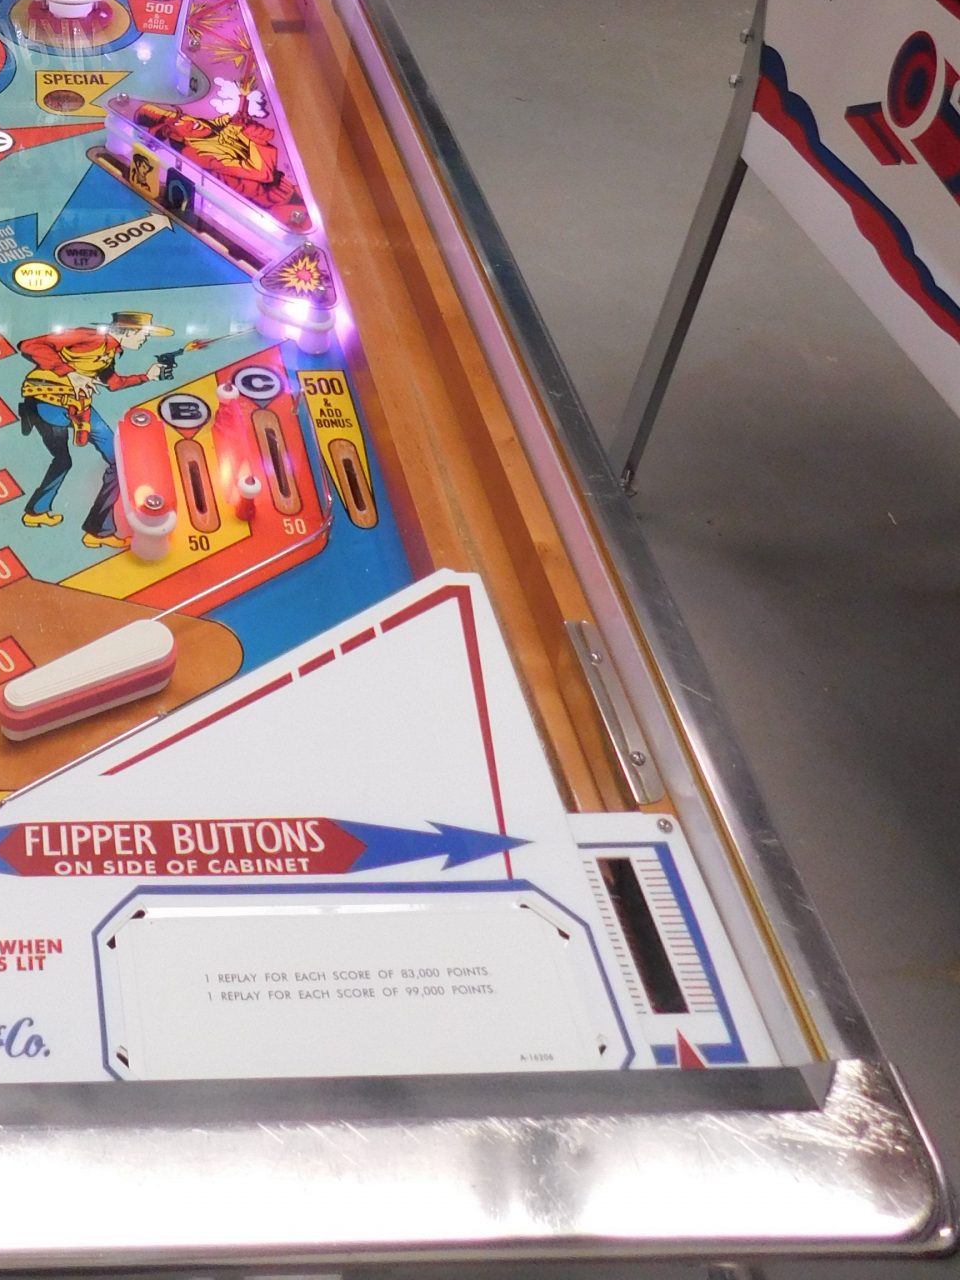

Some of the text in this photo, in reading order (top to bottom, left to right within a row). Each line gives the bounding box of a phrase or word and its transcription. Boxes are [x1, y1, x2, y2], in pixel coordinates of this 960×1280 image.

[145, 3, 174, 14] 500
[43, 73, 109, 86] SPECIAL
[103, 221, 156, 249] 5000
[66, 248, 98, 258] WHEN
[74, 257, 89, 266] LIT
[241, 374, 276, 392] C
[303, 377, 344, 395] 500
[323, 398, 332, 407] &
[169, 402, 202, 420] B
[319, 408, 342, 418] ADD
[316, 418, 353, 428] BONUS
[282, 518, 307, 535] 50
[188, 535, 210, 551] 50
[25, 820, 325, 856] FLIPPER BUTTONS
[54, 857, 309, 875] ON SIDE OF CABINET
[16, 955, 46, 971] LIT
[218, 973, 257, 983] REPLAY
[265, 972, 288, 982] FOR
[295, 971, 326, 981] EACH
[333, 970, 371, 980] SCORE
[378, 969, 394, 979] OF
